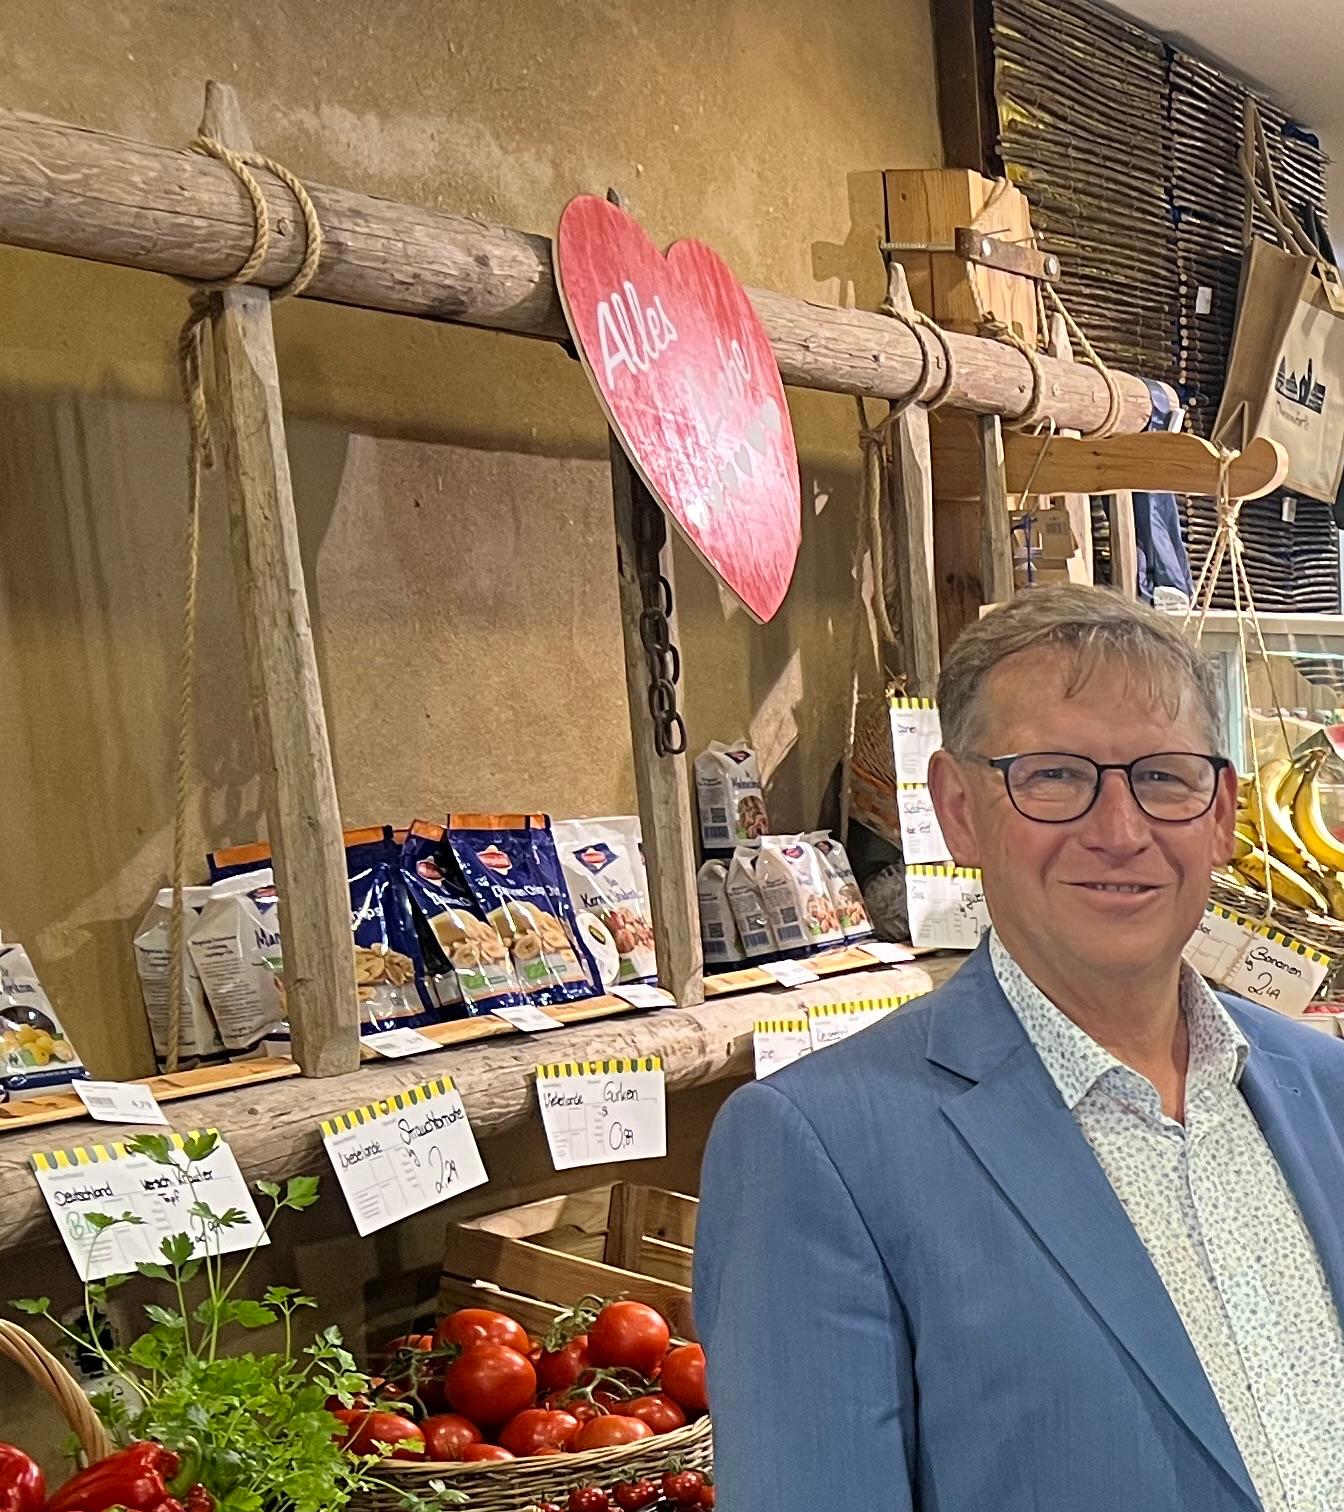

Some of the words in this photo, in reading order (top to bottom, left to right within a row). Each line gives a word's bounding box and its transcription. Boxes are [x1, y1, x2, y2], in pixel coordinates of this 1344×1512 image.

[596, 280, 679, 391] Alles
[1250, 947, 1302, 978] Bananen
[603, 1081, 639, 1102] Gurken
[609, 1121, 634, 1151] 0,89
[54, 1180, 115, 1207] Deutschland
